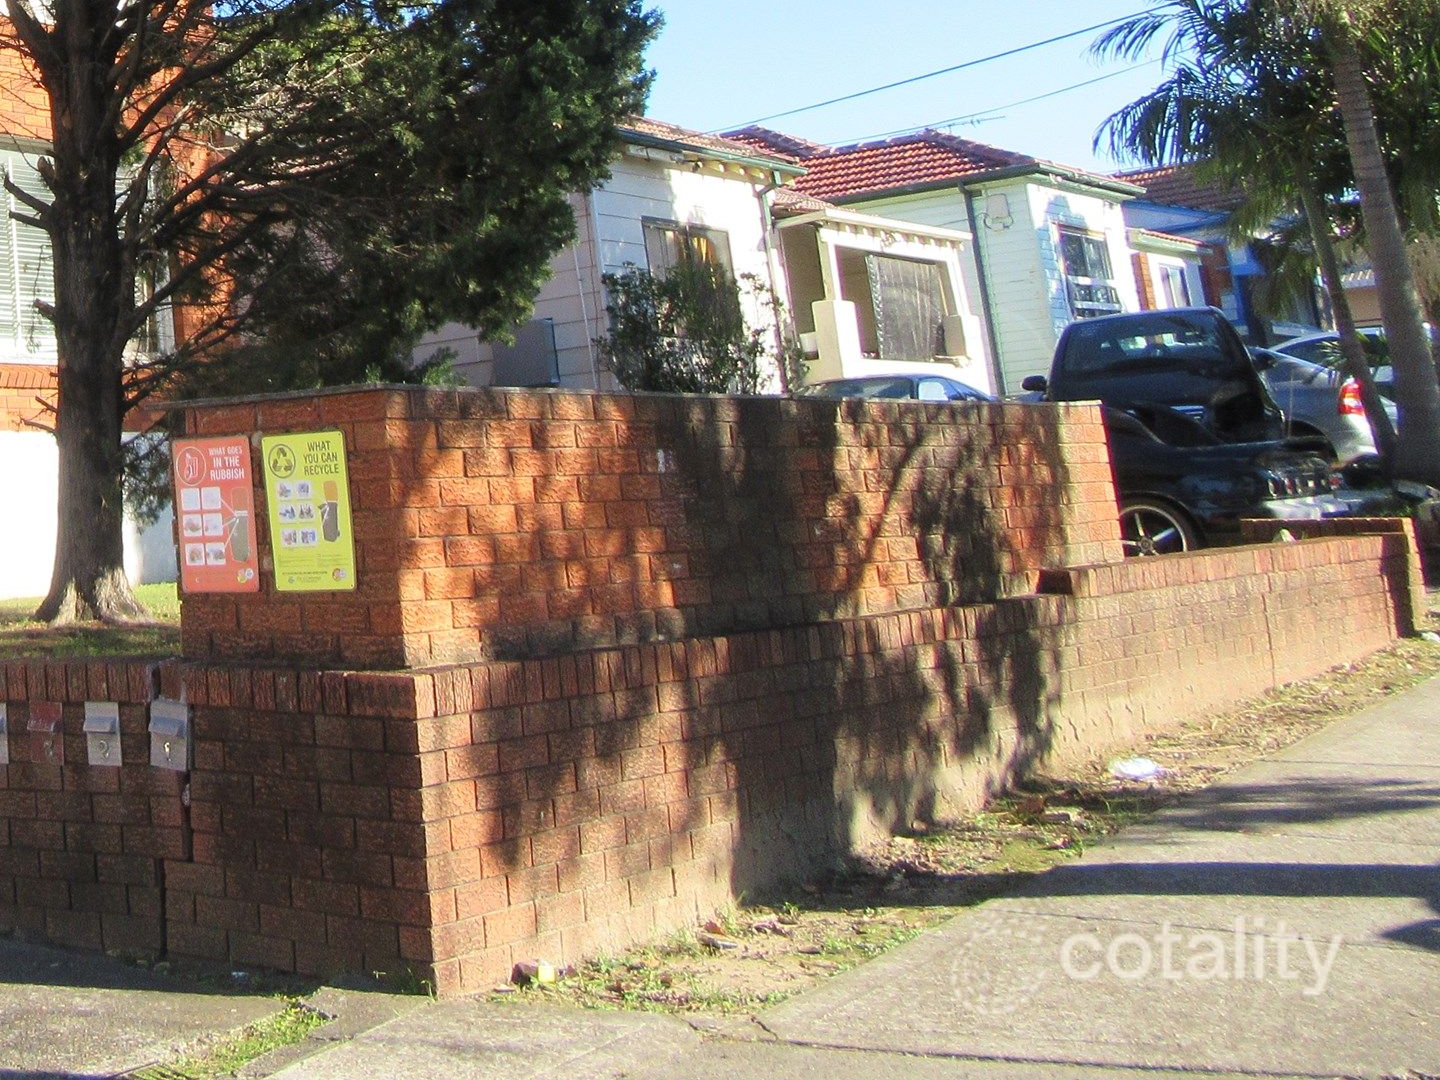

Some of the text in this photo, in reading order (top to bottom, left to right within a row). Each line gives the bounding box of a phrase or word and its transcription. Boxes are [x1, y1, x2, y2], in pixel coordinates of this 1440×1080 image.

[208, 445, 243, 456] WHAT GOES
[307, 440, 331, 452] WHAT
[212, 456, 240, 468] IN THE
[303, 452, 338, 463] YOU CAN
[210, 468, 245, 480] RUBBISH
[304, 463, 339, 476] RECYCLE
